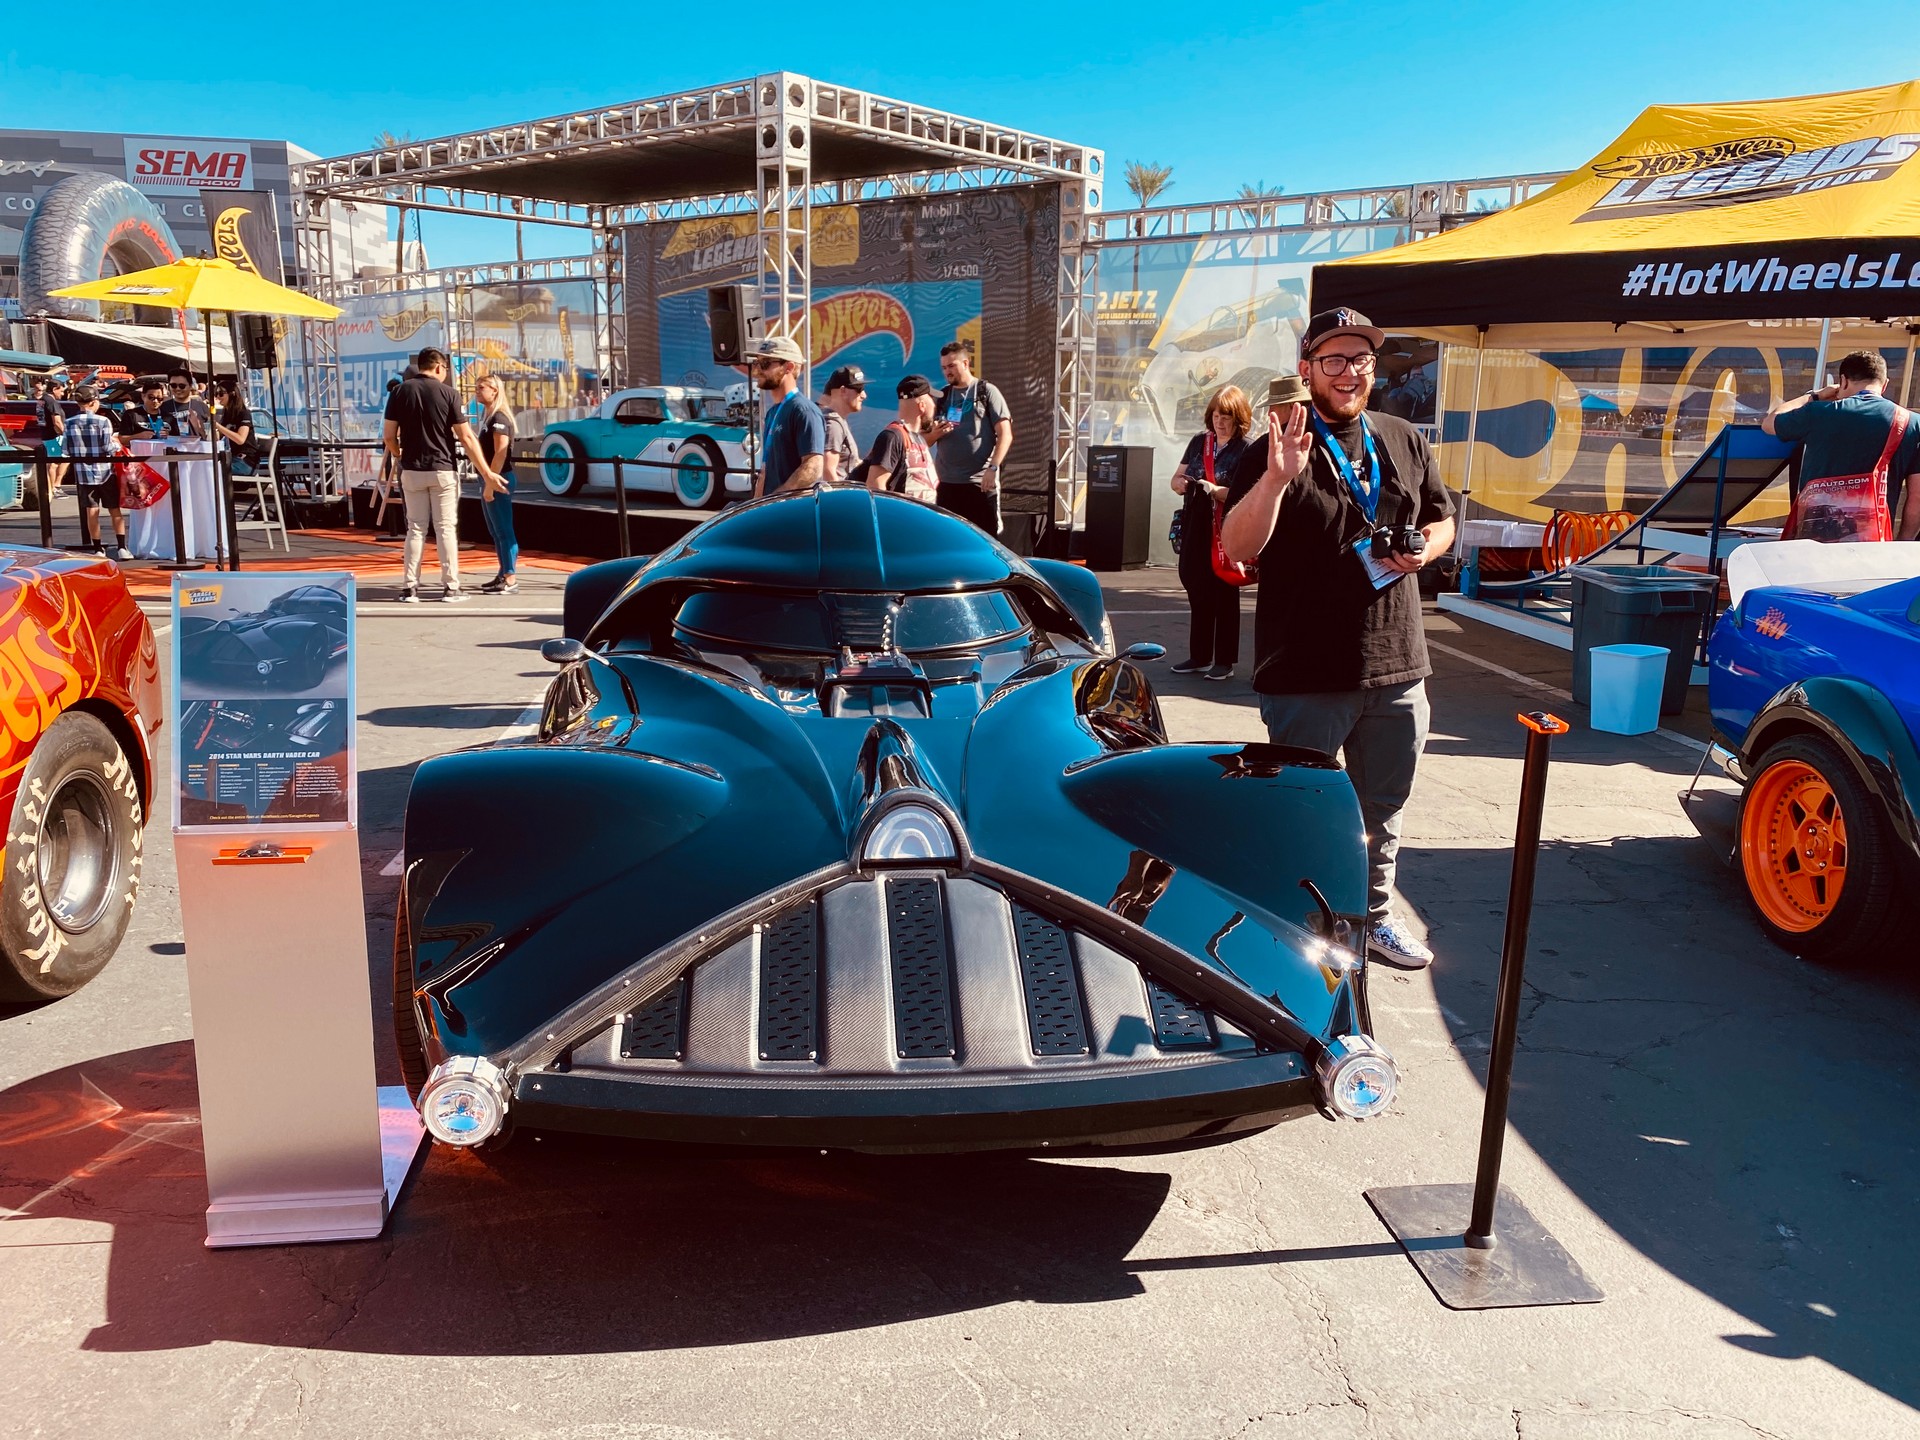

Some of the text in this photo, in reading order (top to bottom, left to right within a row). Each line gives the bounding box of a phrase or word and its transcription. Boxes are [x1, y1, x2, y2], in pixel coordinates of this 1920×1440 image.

[135, 149, 247, 178] SEMA
[1592, 133, 1920, 208] LEGENDS
[188, 179, 239, 187] SHOW
[1791, 168, 1880, 195] TOUR
[921, 203, 952, 219] Mobil
[954, 202, 961, 216] 1
[692, 233, 769, 272] LEGEND
[741, 260, 760, 273] TOU
[1097, 290, 1158, 310] 2 JET Z
[1466, 357, 1512, 367] NRTH
